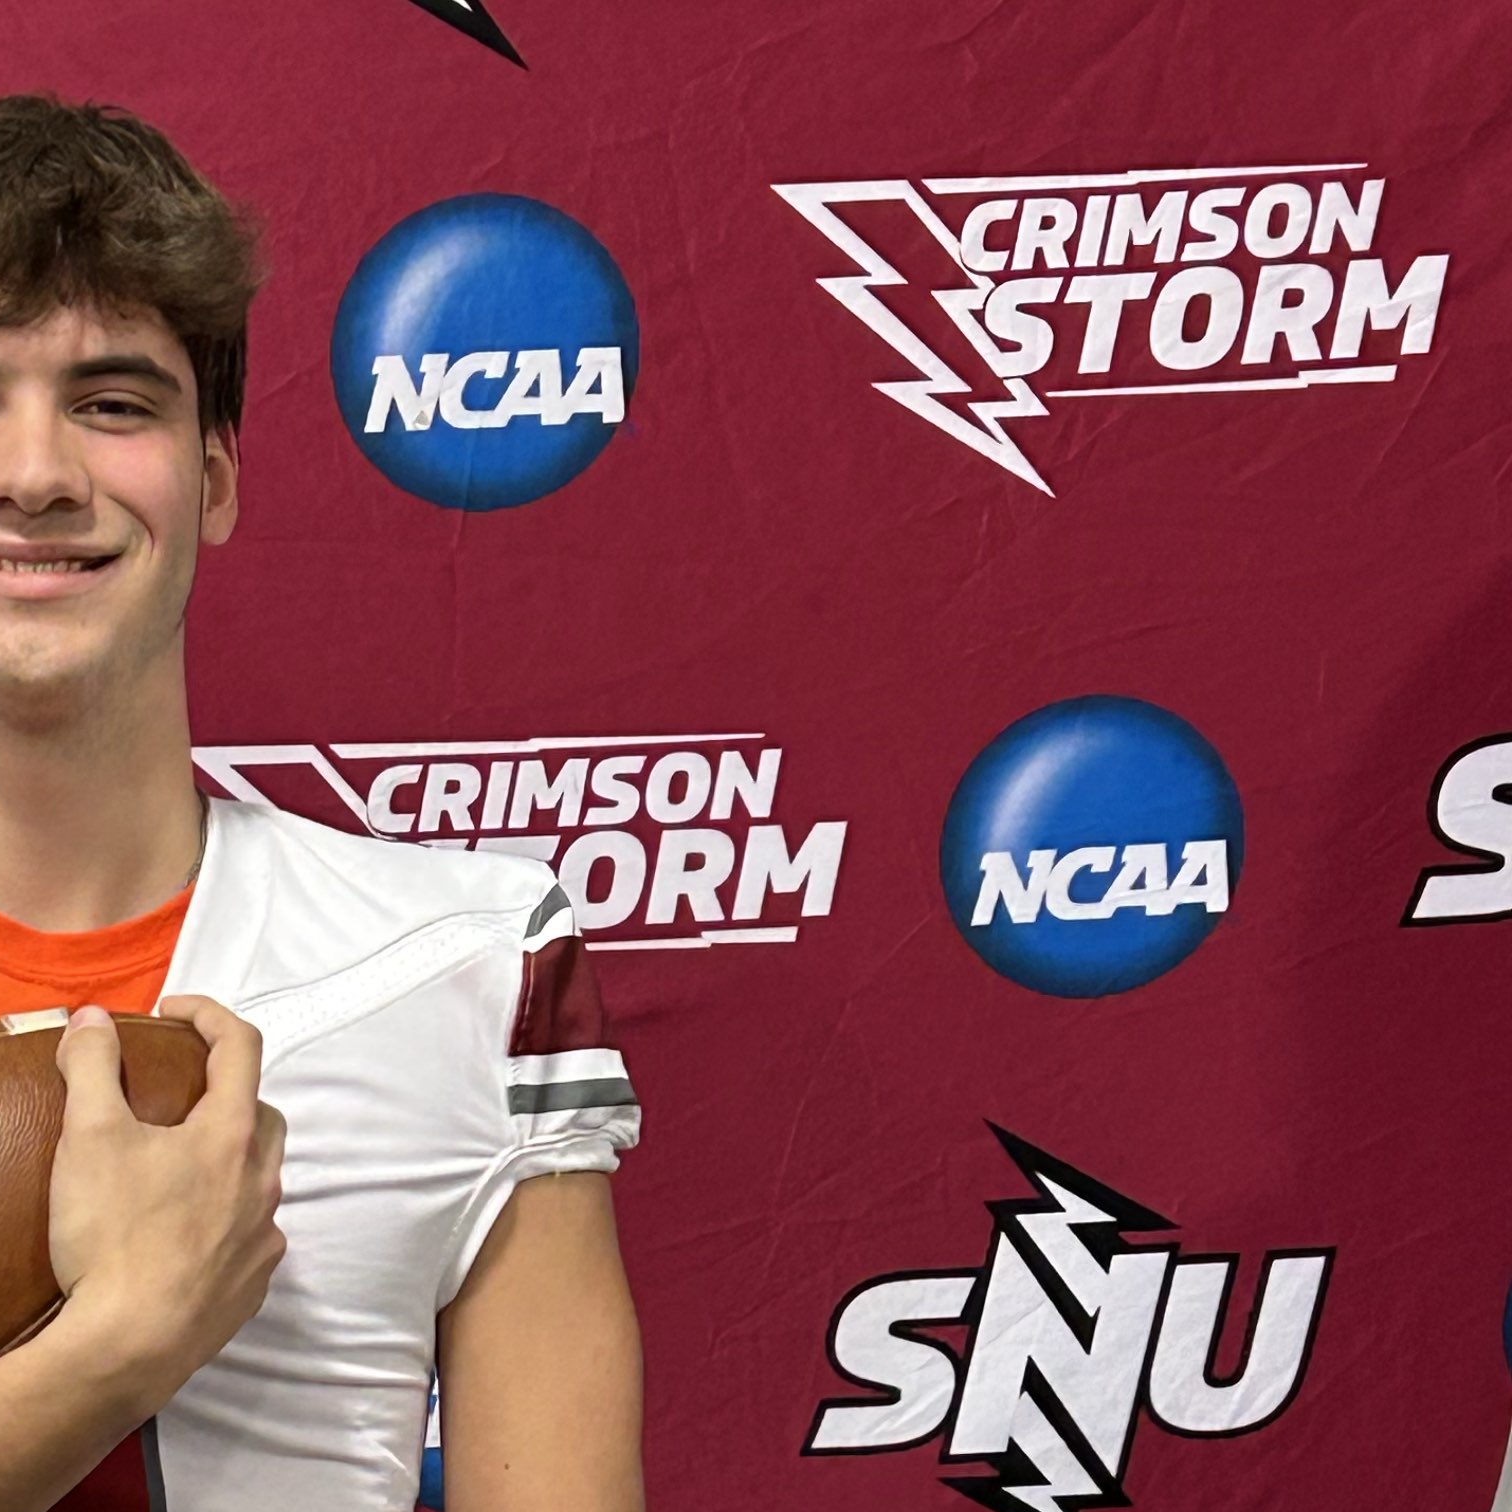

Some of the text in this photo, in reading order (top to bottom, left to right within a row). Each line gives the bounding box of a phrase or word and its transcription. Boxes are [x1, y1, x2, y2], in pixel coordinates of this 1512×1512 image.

[960, 178, 1386, 273] CRIMSON
[984, 254, 1449, 378] STORM
[363, 346, 625, 433] NCAA
[367, 748, 782, 834] CRIMSON
[476, 821, 847, 930] ORM
[971, 838, 1229, 927] NCAA
